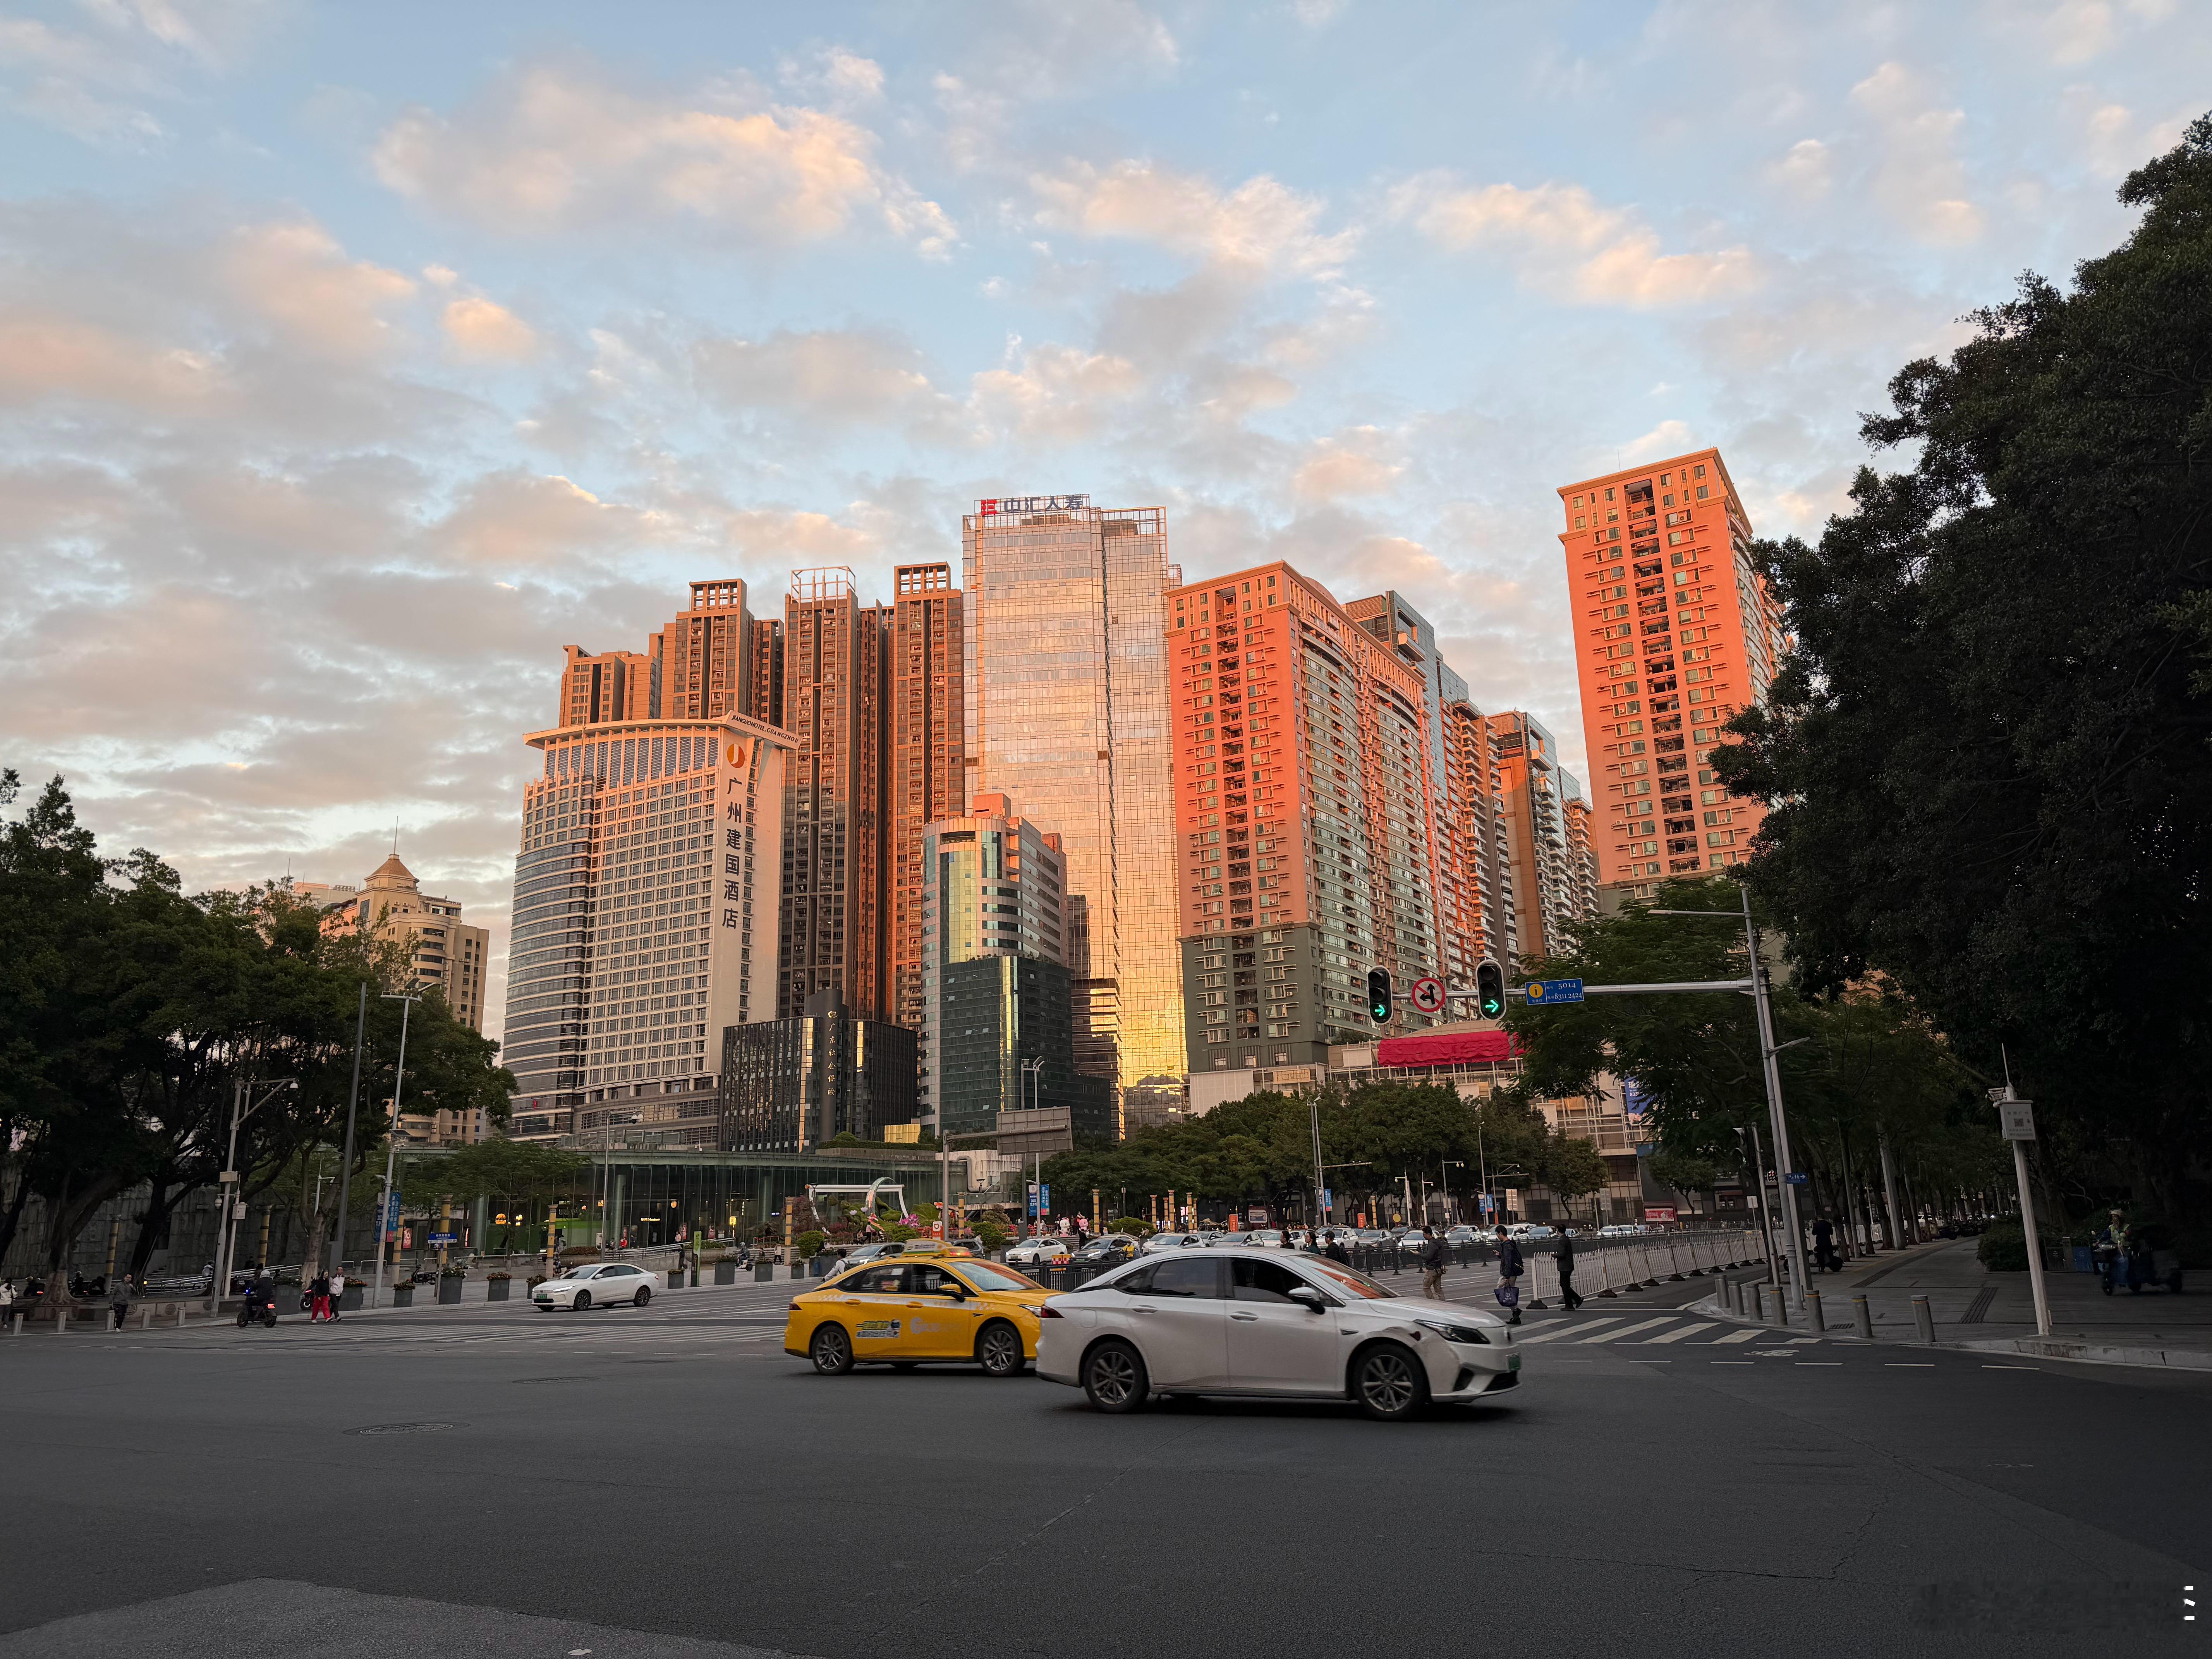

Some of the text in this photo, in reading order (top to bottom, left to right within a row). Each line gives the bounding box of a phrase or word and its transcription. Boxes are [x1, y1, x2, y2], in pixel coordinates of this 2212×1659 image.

[1004, 495, 1083, 512] 中汇人寿
[722, 777, 742, 929] 广州建国酒店
